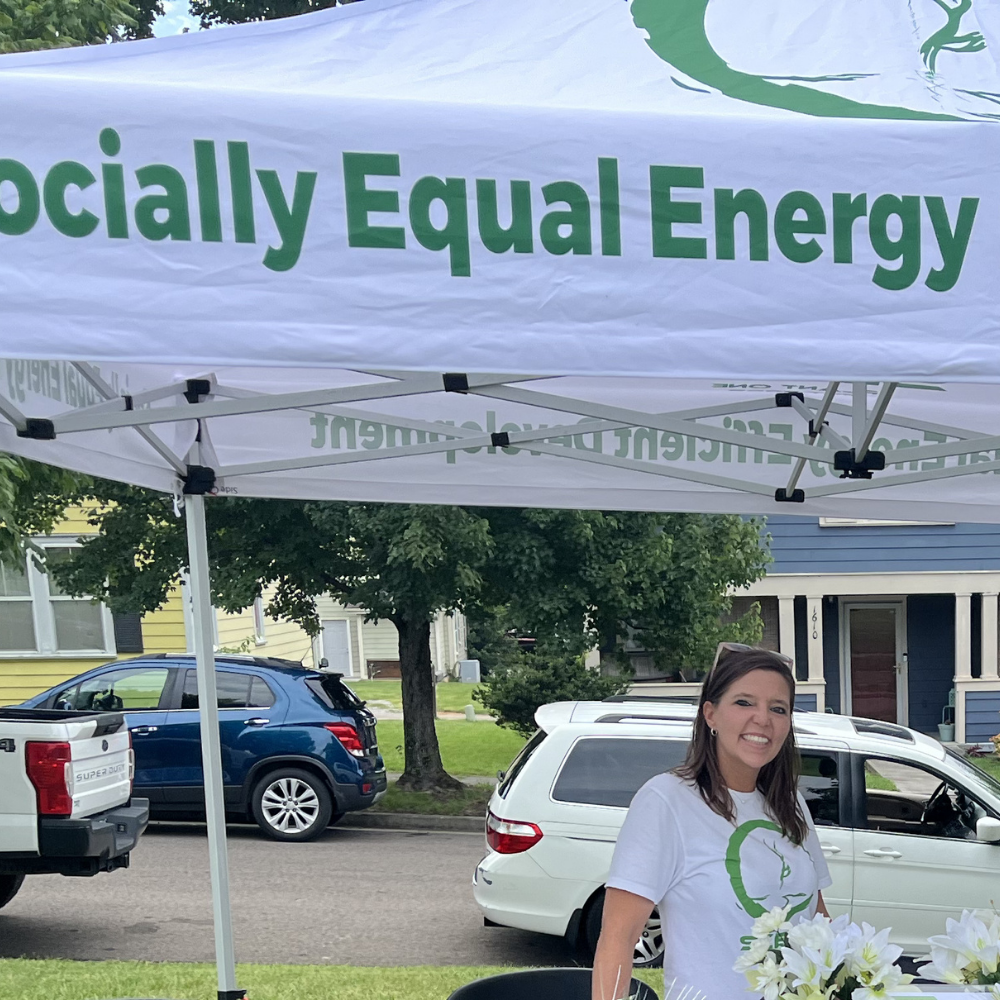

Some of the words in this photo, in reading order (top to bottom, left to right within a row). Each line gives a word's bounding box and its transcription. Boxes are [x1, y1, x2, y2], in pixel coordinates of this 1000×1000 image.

[343, 152, 622, 277] Equal
[651, 165, 979, 292] Energy
[76, 767, 107, 782] SUPER
[109, 763, 125, 776] DUTY
